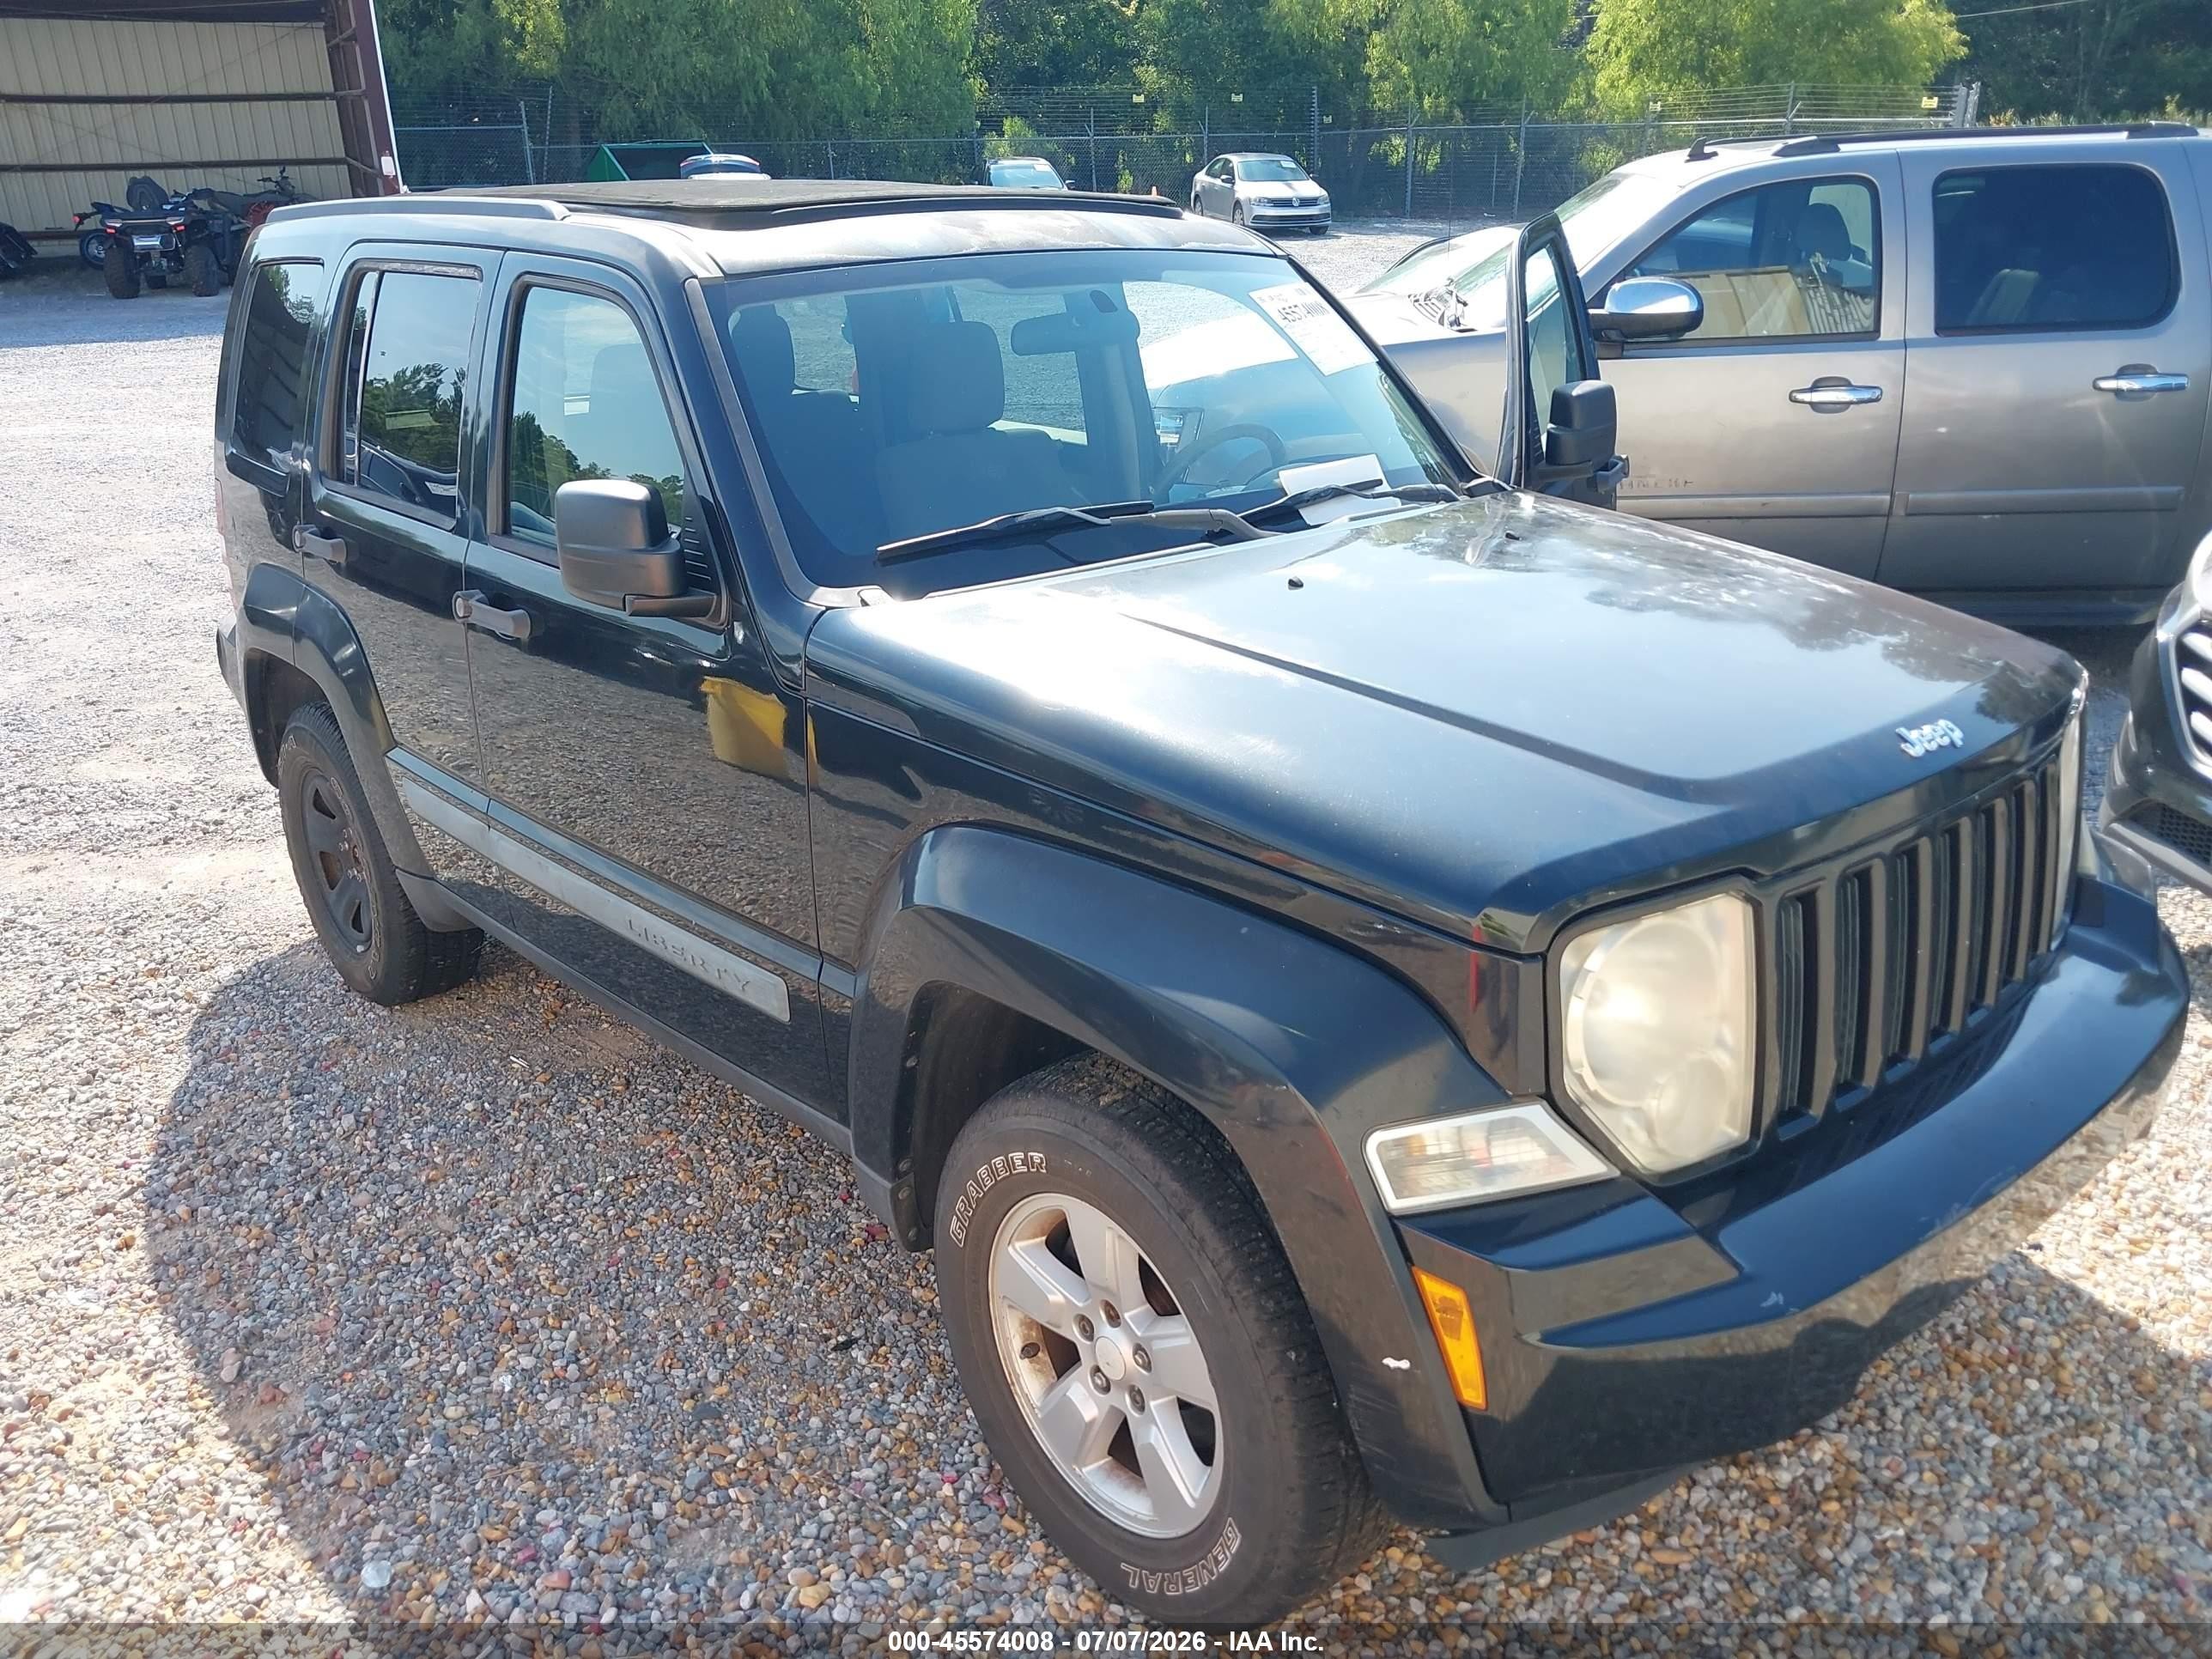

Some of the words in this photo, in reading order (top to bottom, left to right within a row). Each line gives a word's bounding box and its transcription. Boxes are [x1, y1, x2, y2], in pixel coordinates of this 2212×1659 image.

[1895, 719, 1964, 757] Jeep
[950, 1152, 1047, 1248] GRABBER
[1120, 1517, 1242, 1595] GENERAL
